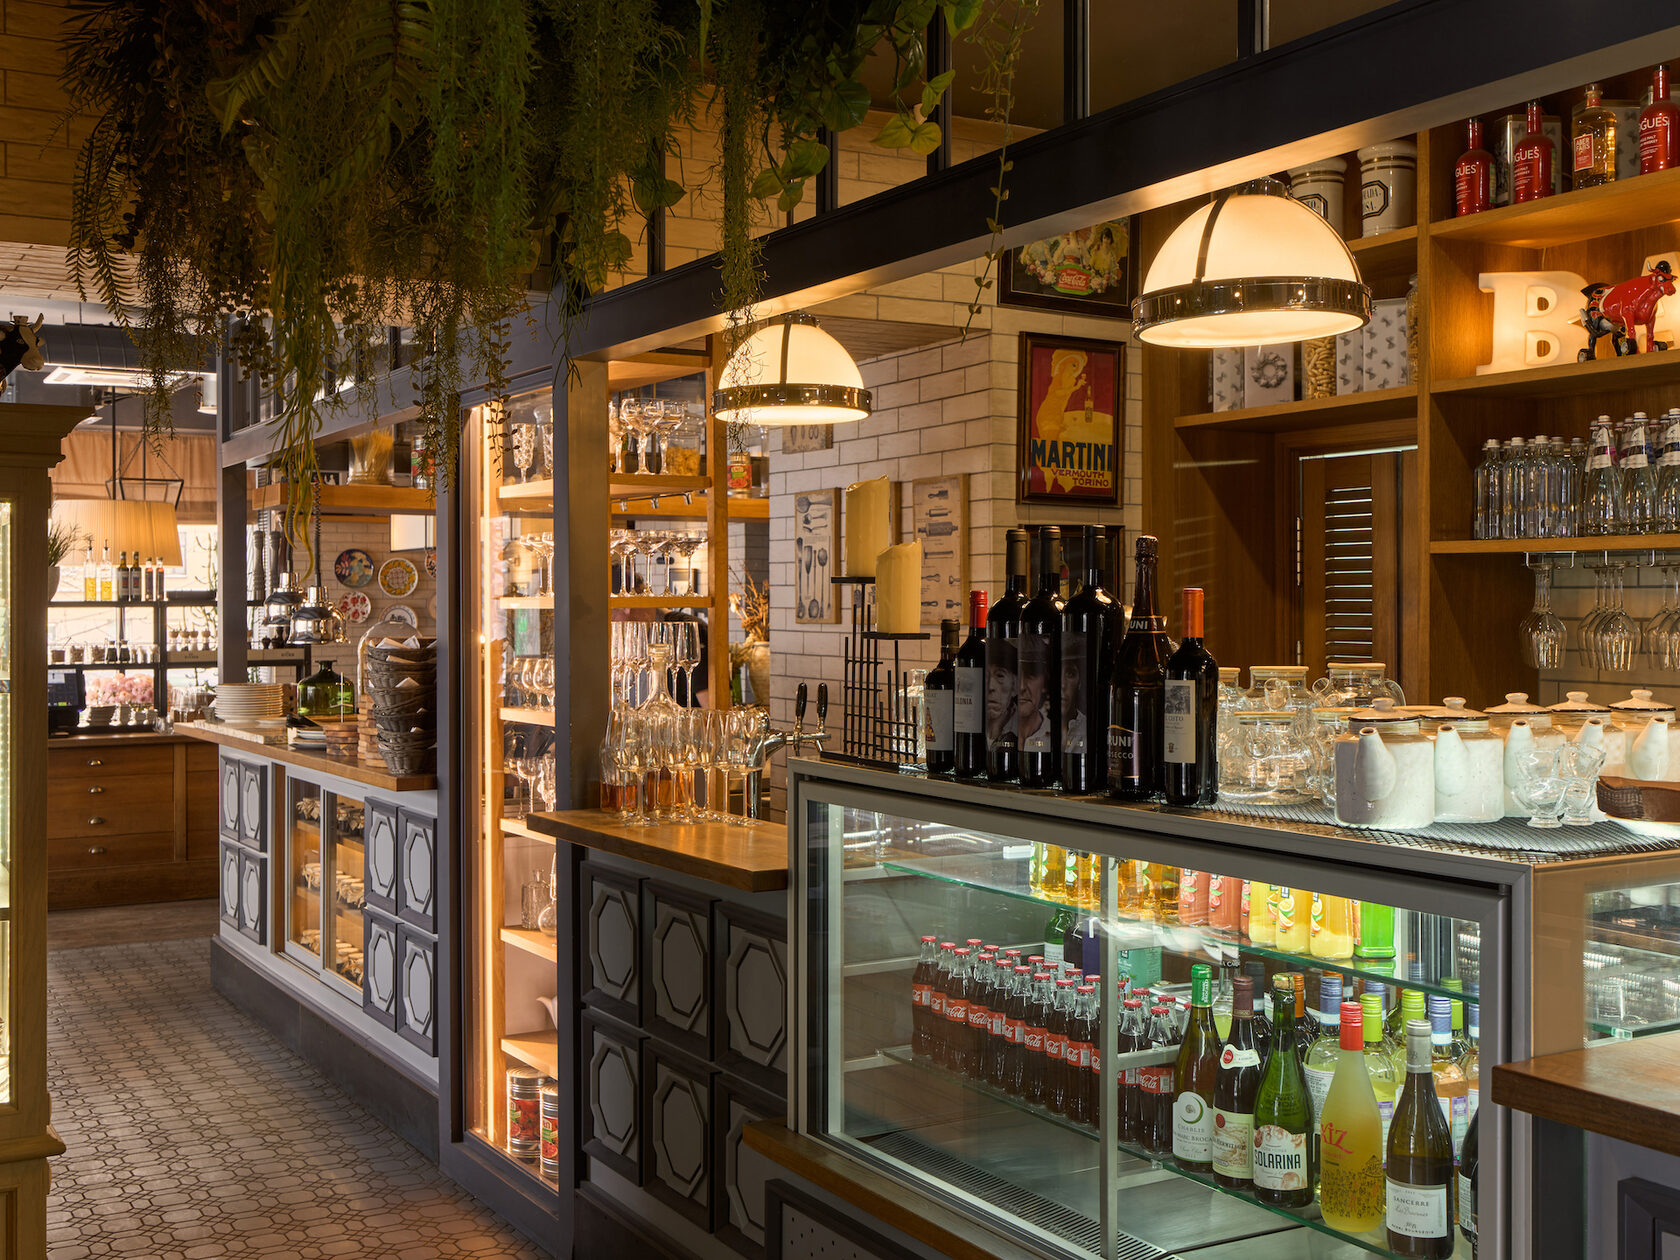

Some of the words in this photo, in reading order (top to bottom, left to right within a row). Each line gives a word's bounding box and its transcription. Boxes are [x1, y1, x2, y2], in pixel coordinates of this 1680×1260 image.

[1641, 116, 1670, 131] GUES
[1514, 148, 1540, 162] GUES
[1031, 438, 1112, 472] MARTINI
[1051, 468, 1104, 479] VERMOUTH
[1072, 477, 1109, 487] TORINO
[1129, 619, 1149, 630] UNI
[1254, 1149, 1301, 1169] SOLARINA
[1393, 1196, 1430, 1207] SANCERRE
